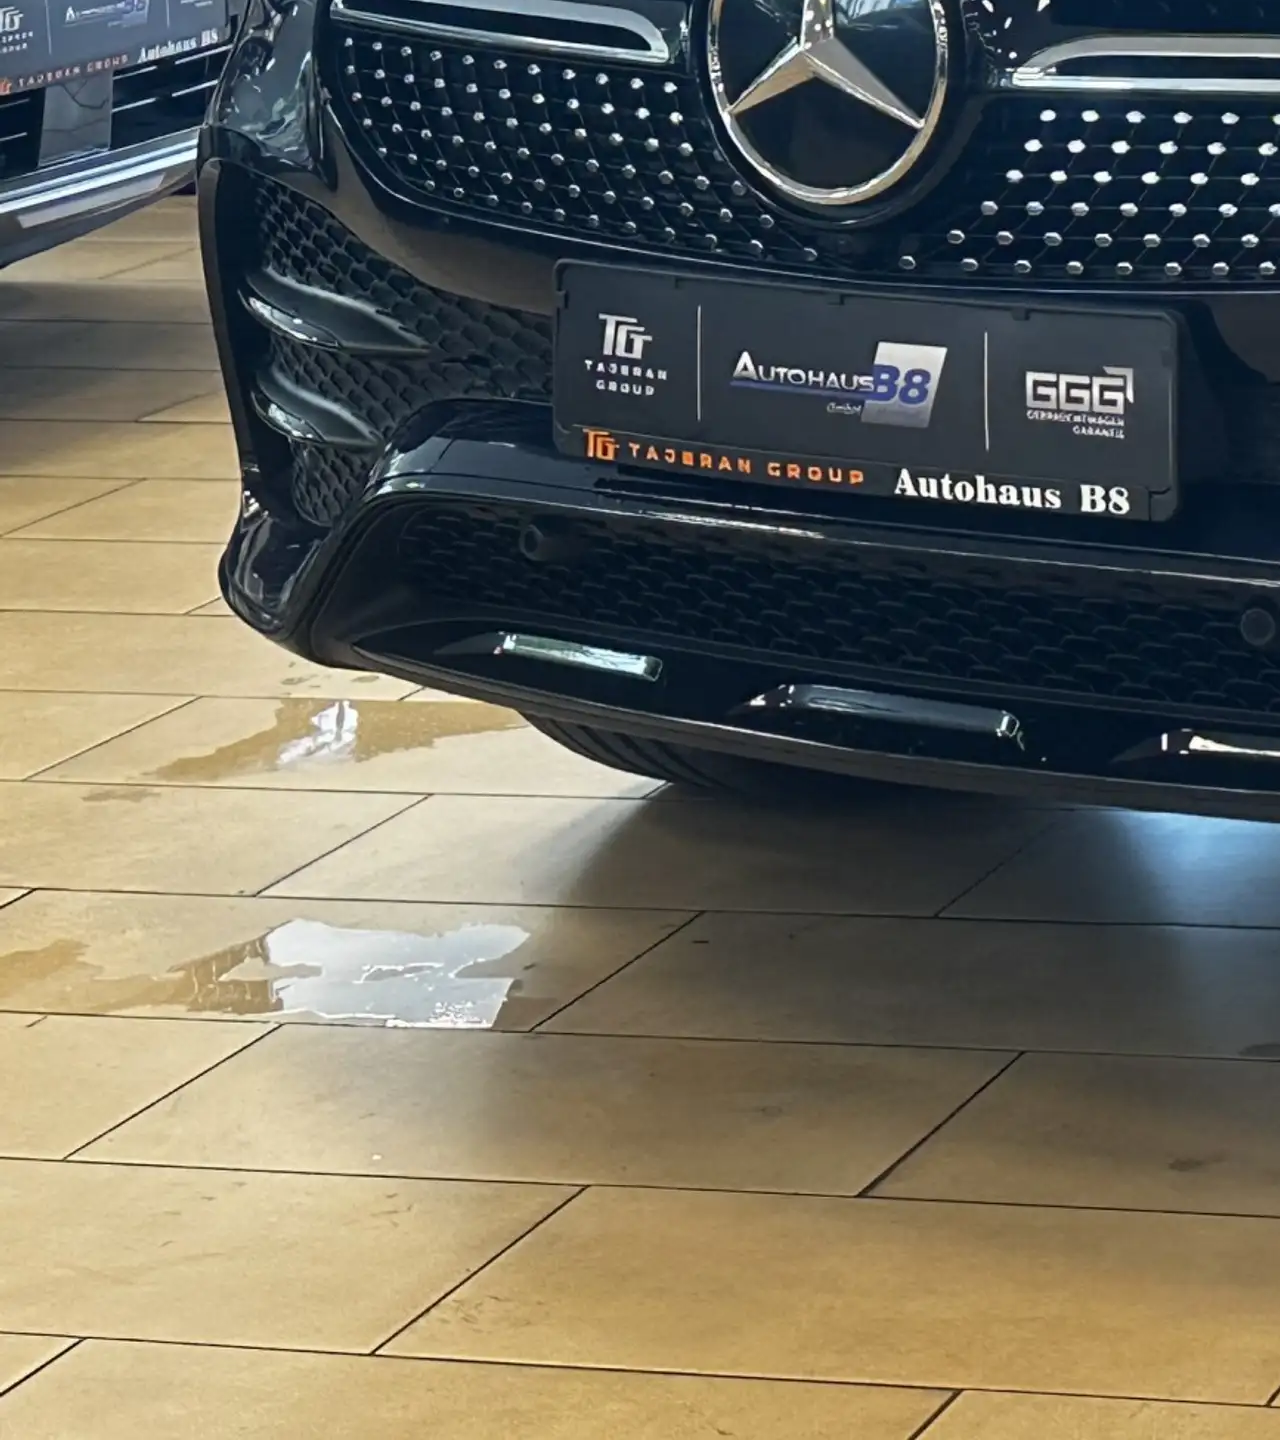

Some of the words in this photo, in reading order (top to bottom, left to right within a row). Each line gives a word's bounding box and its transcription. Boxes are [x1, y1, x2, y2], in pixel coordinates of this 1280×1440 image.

[872, 364, 931, 404] B8
[767, 461, 864, 485] GROUP
[894, 467, 1062, 510] Autohaus
[1080, 484, 1130, 516] B8
